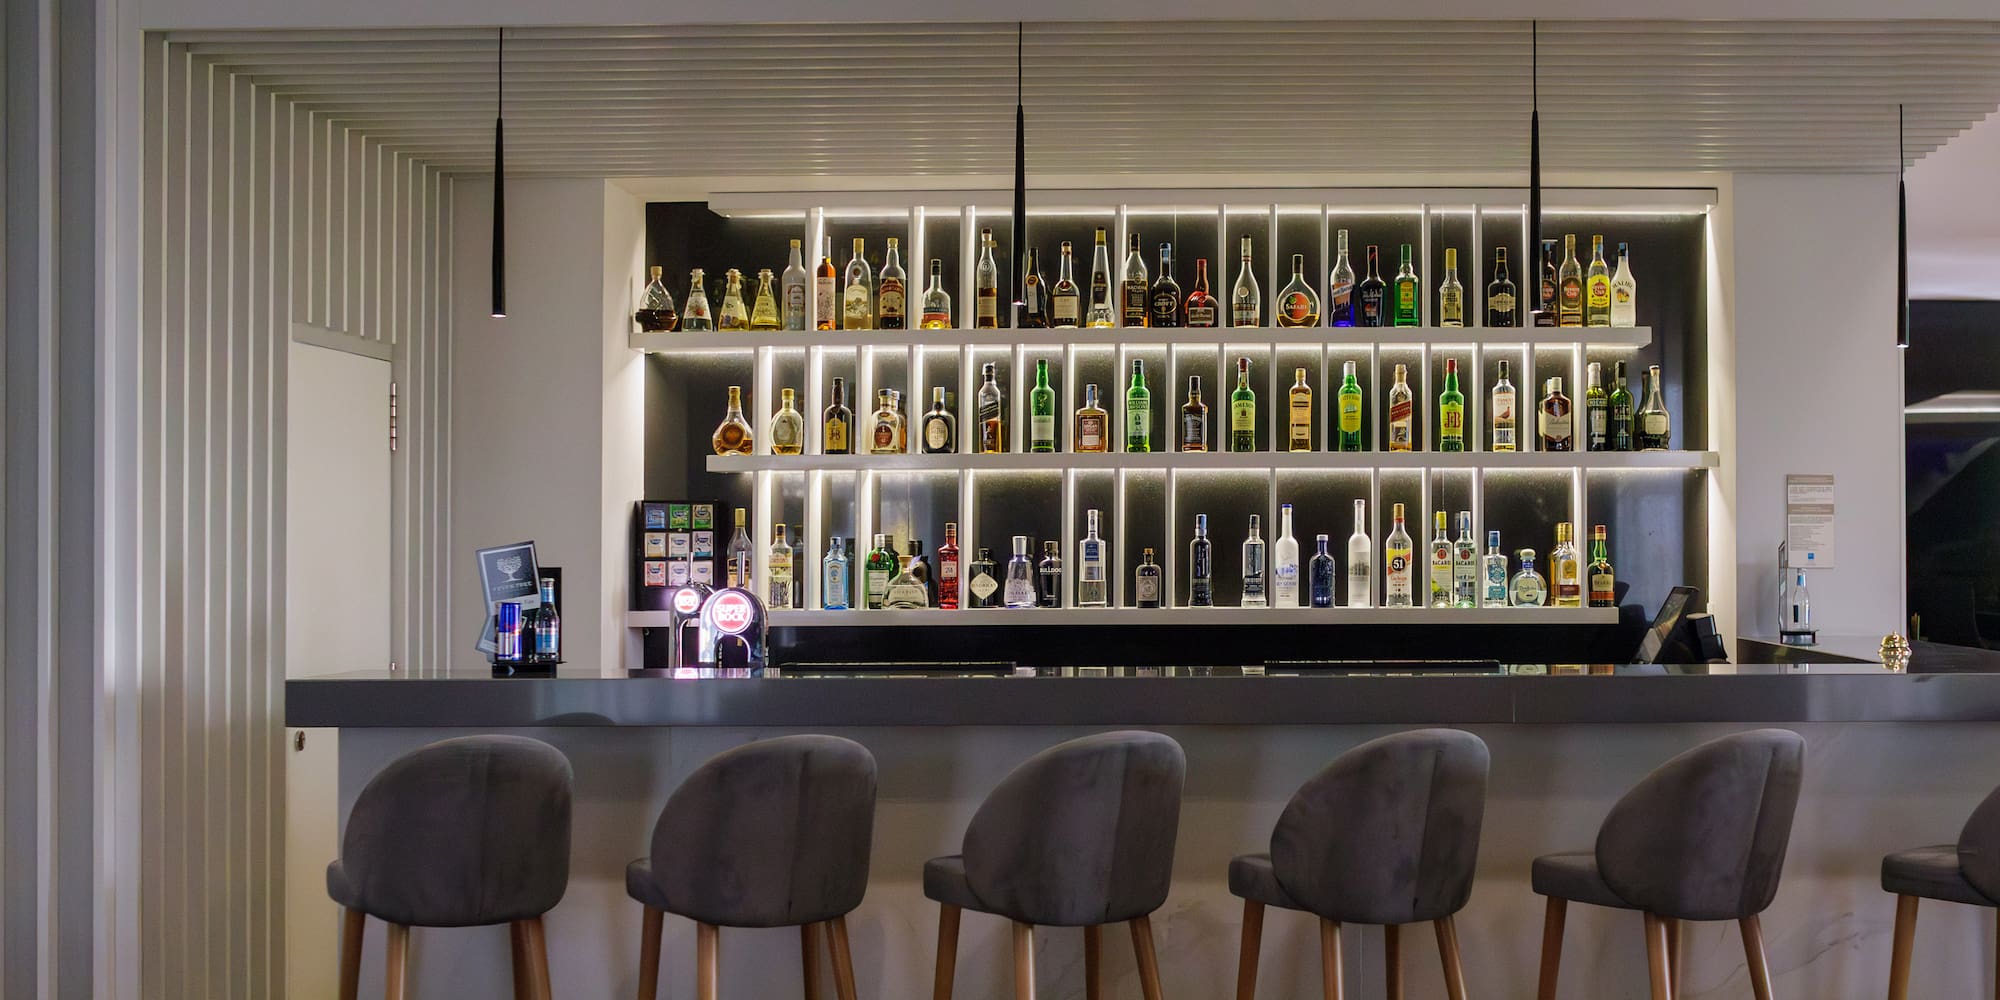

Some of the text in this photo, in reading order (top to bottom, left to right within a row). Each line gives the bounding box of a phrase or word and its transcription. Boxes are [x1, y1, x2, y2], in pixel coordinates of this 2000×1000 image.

[1393, 559, 1404, 570] 51
[716, 603, 747, 614] SUPER
[717, 612, 746, 623] BOCK
